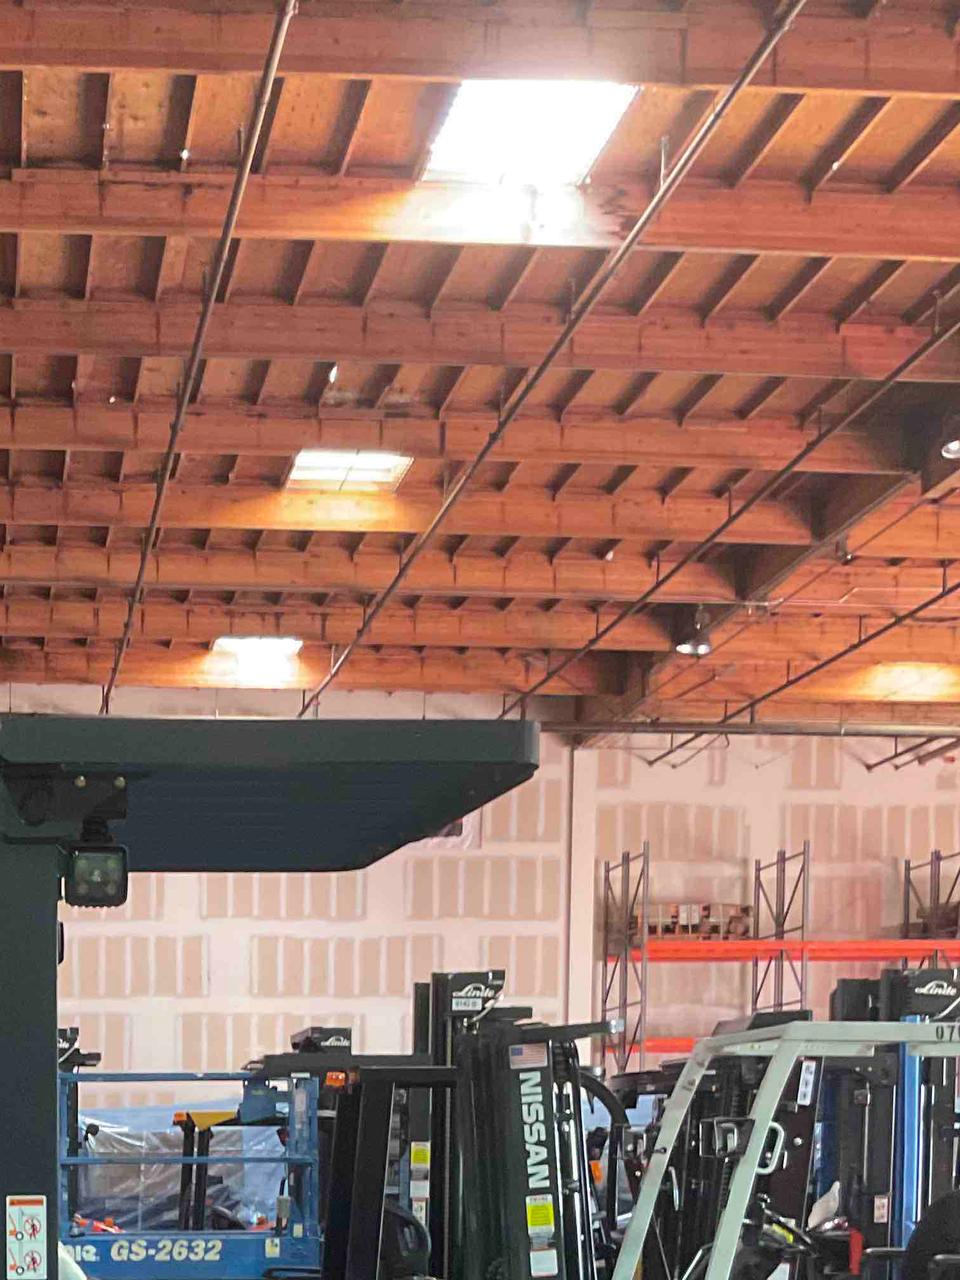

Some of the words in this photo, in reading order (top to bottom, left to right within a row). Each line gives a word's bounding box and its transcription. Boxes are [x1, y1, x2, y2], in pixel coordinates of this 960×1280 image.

[452, 983, 495, 997] Linde
[915, 980, 957, 995] Linde
[320, 1035, 350, 1047] Linde
[519, 1070, 550, 1190] NISSAN
[111, 1239, 223, 1261] GS-2632
